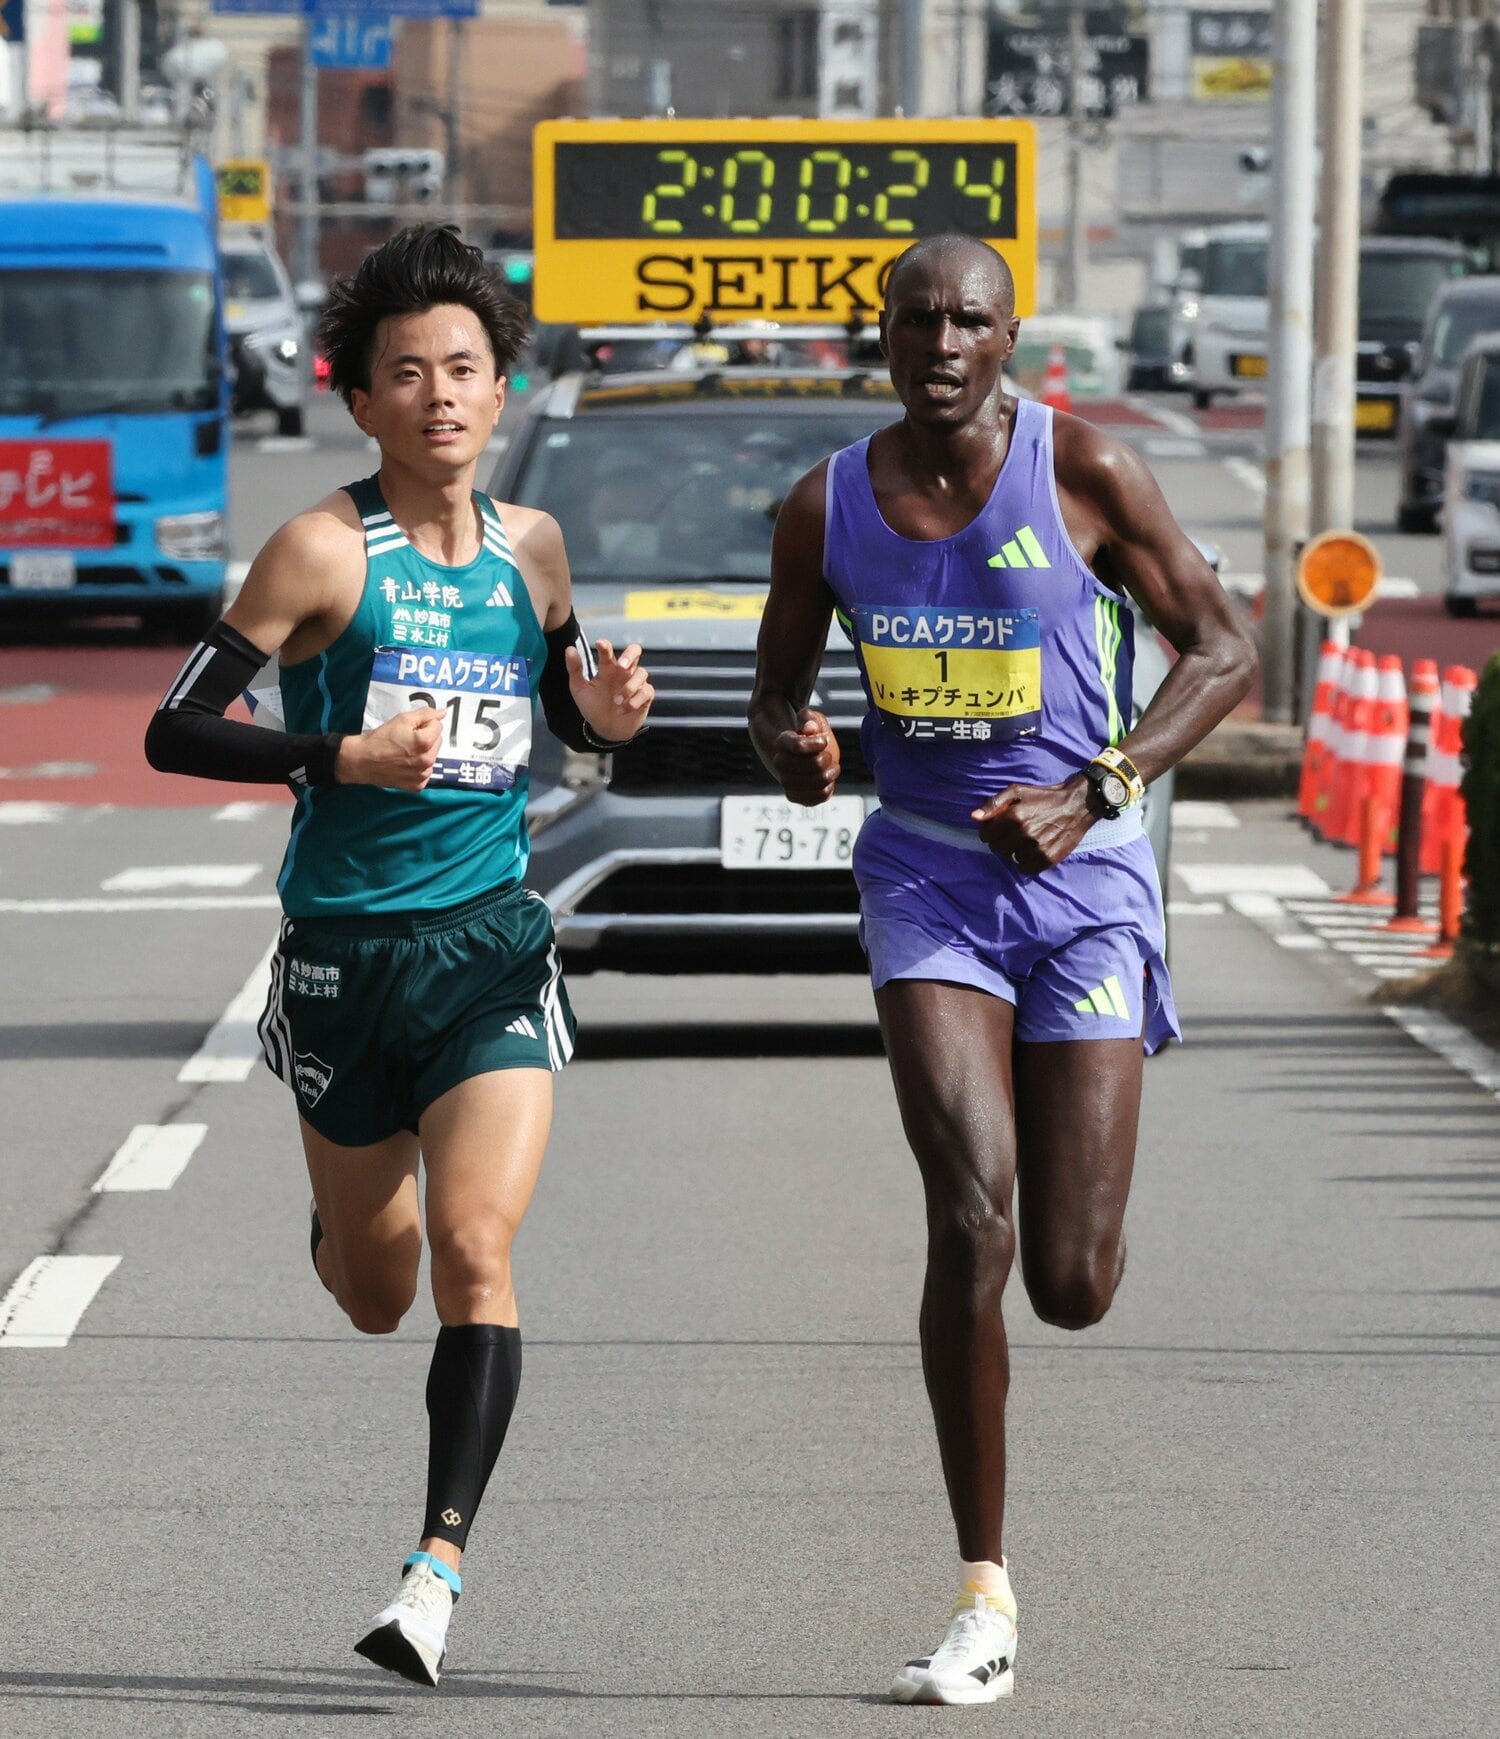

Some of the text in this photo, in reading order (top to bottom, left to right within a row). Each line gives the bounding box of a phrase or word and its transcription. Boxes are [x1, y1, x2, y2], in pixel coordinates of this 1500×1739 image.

[642, 150, 1005, 233] 2:00:24
[379, 576, 464, 608] 青山学院
[413, 608, 451, 627] 妙高市
[872, 614, 1013, 646] PCAクラウド
[410, 629, 448, 647] 水上村
[398, 653, 519, 690] PCAクラウド
[934, 651, 948, 683] 1
[900, 719, 992, 741] ソニー生命
[755, 827, 851, 861] 79-78
[300, 963, 340, 981] 妙高市
[298, 982, 338, 998] 水上村
